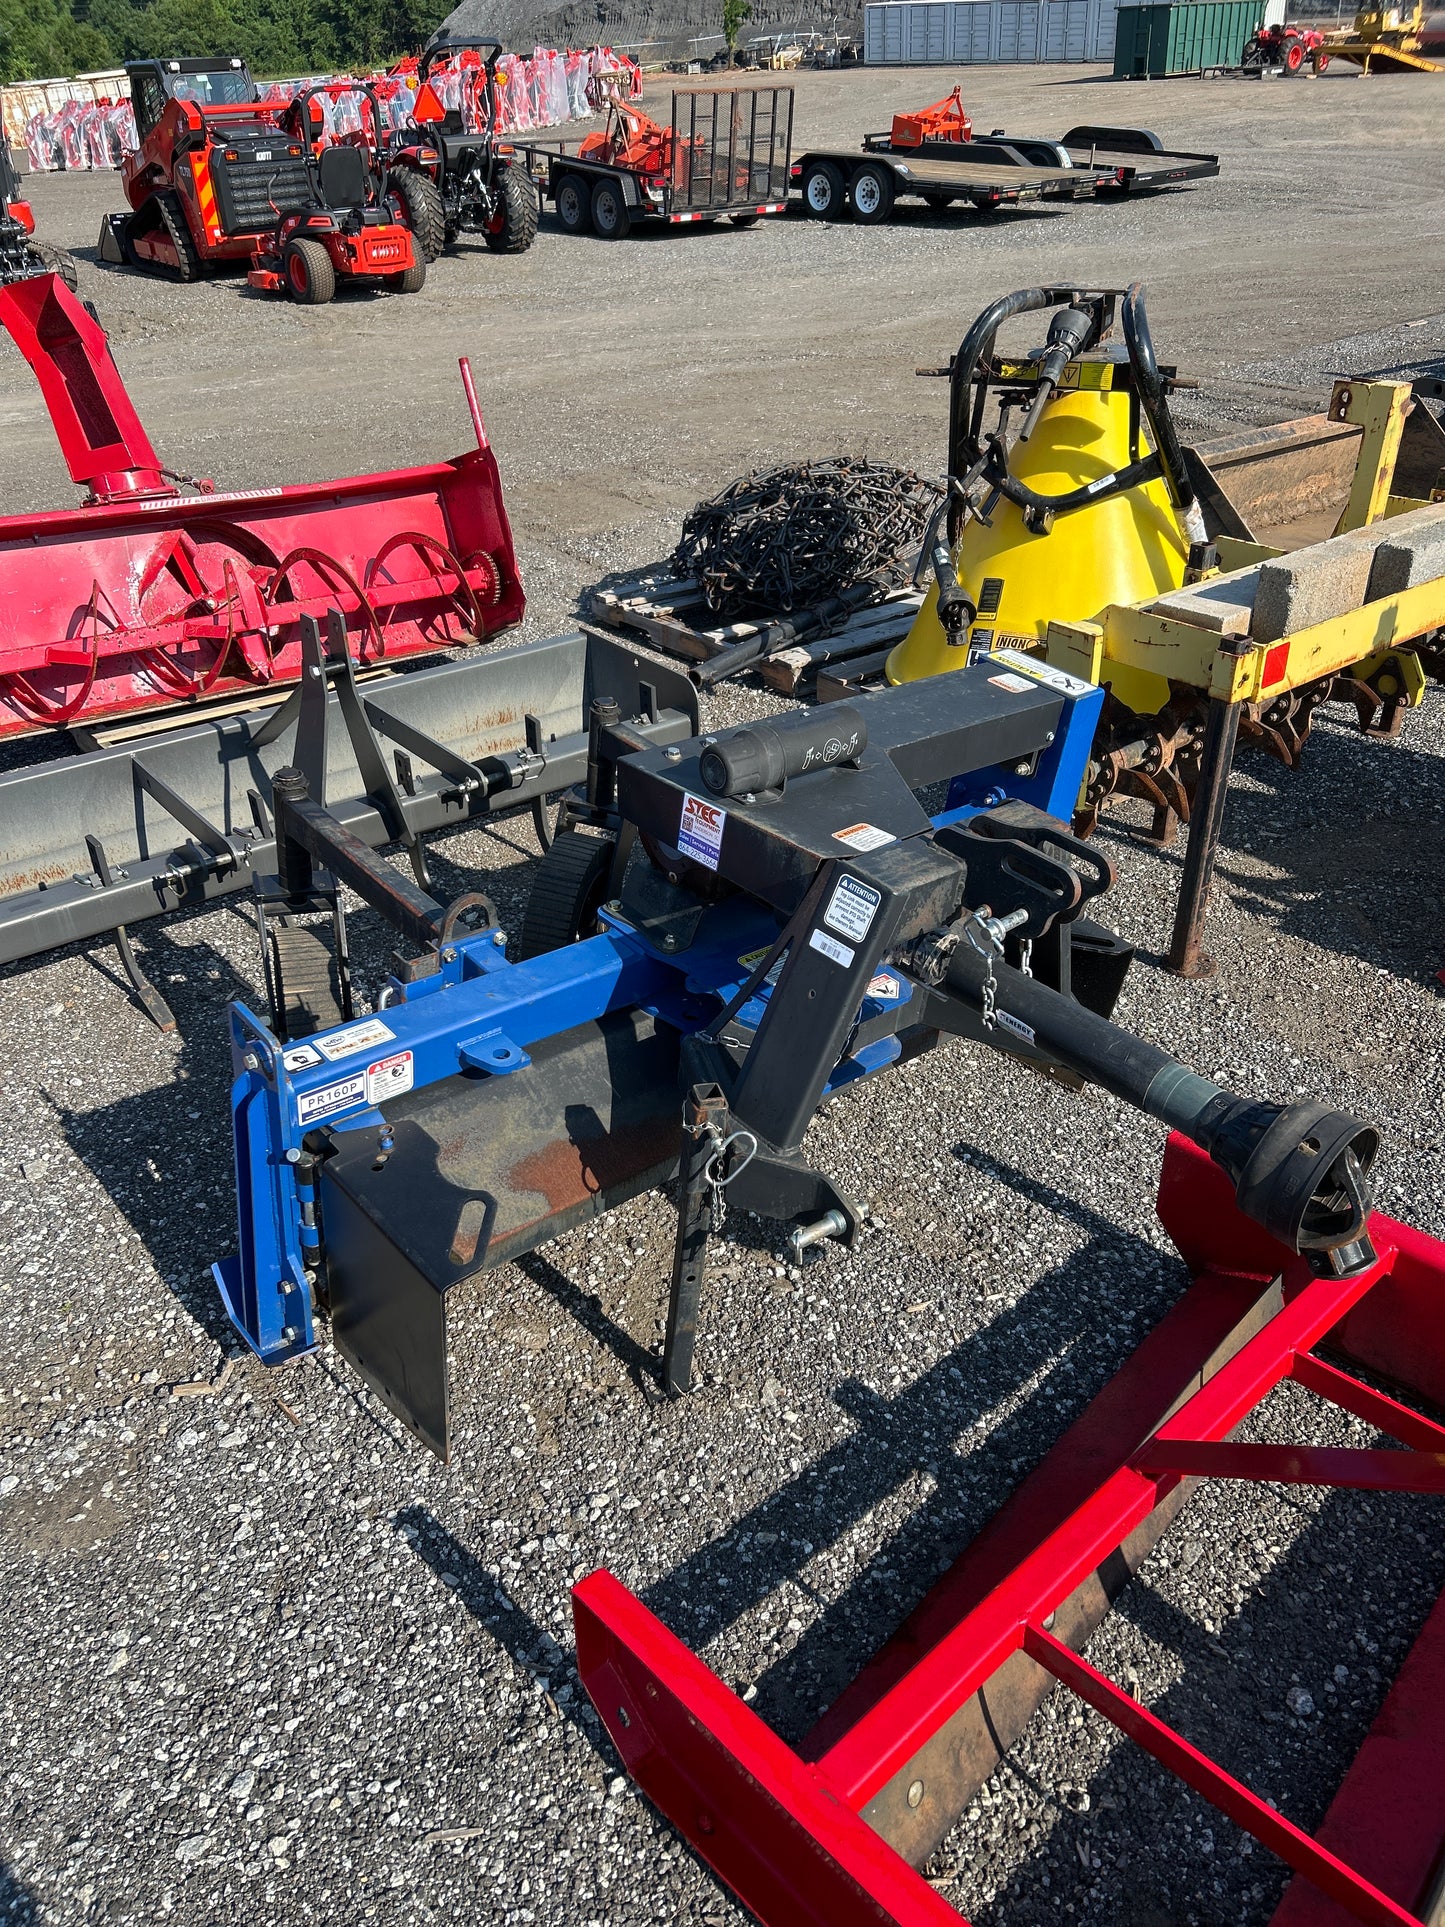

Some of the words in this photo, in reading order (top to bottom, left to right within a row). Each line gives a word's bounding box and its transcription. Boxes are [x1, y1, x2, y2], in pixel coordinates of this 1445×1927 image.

[371, 243, 400, 260] KIOTI
[684, 797, 721, 826] STEC
[694, 816, 721, 835] EQUIPMENT
[848, 882, 877, 903] ATTENTION
[382, 1055, 407, 1069] DANGER
[308, 1082, 357, 1109] PR160P
